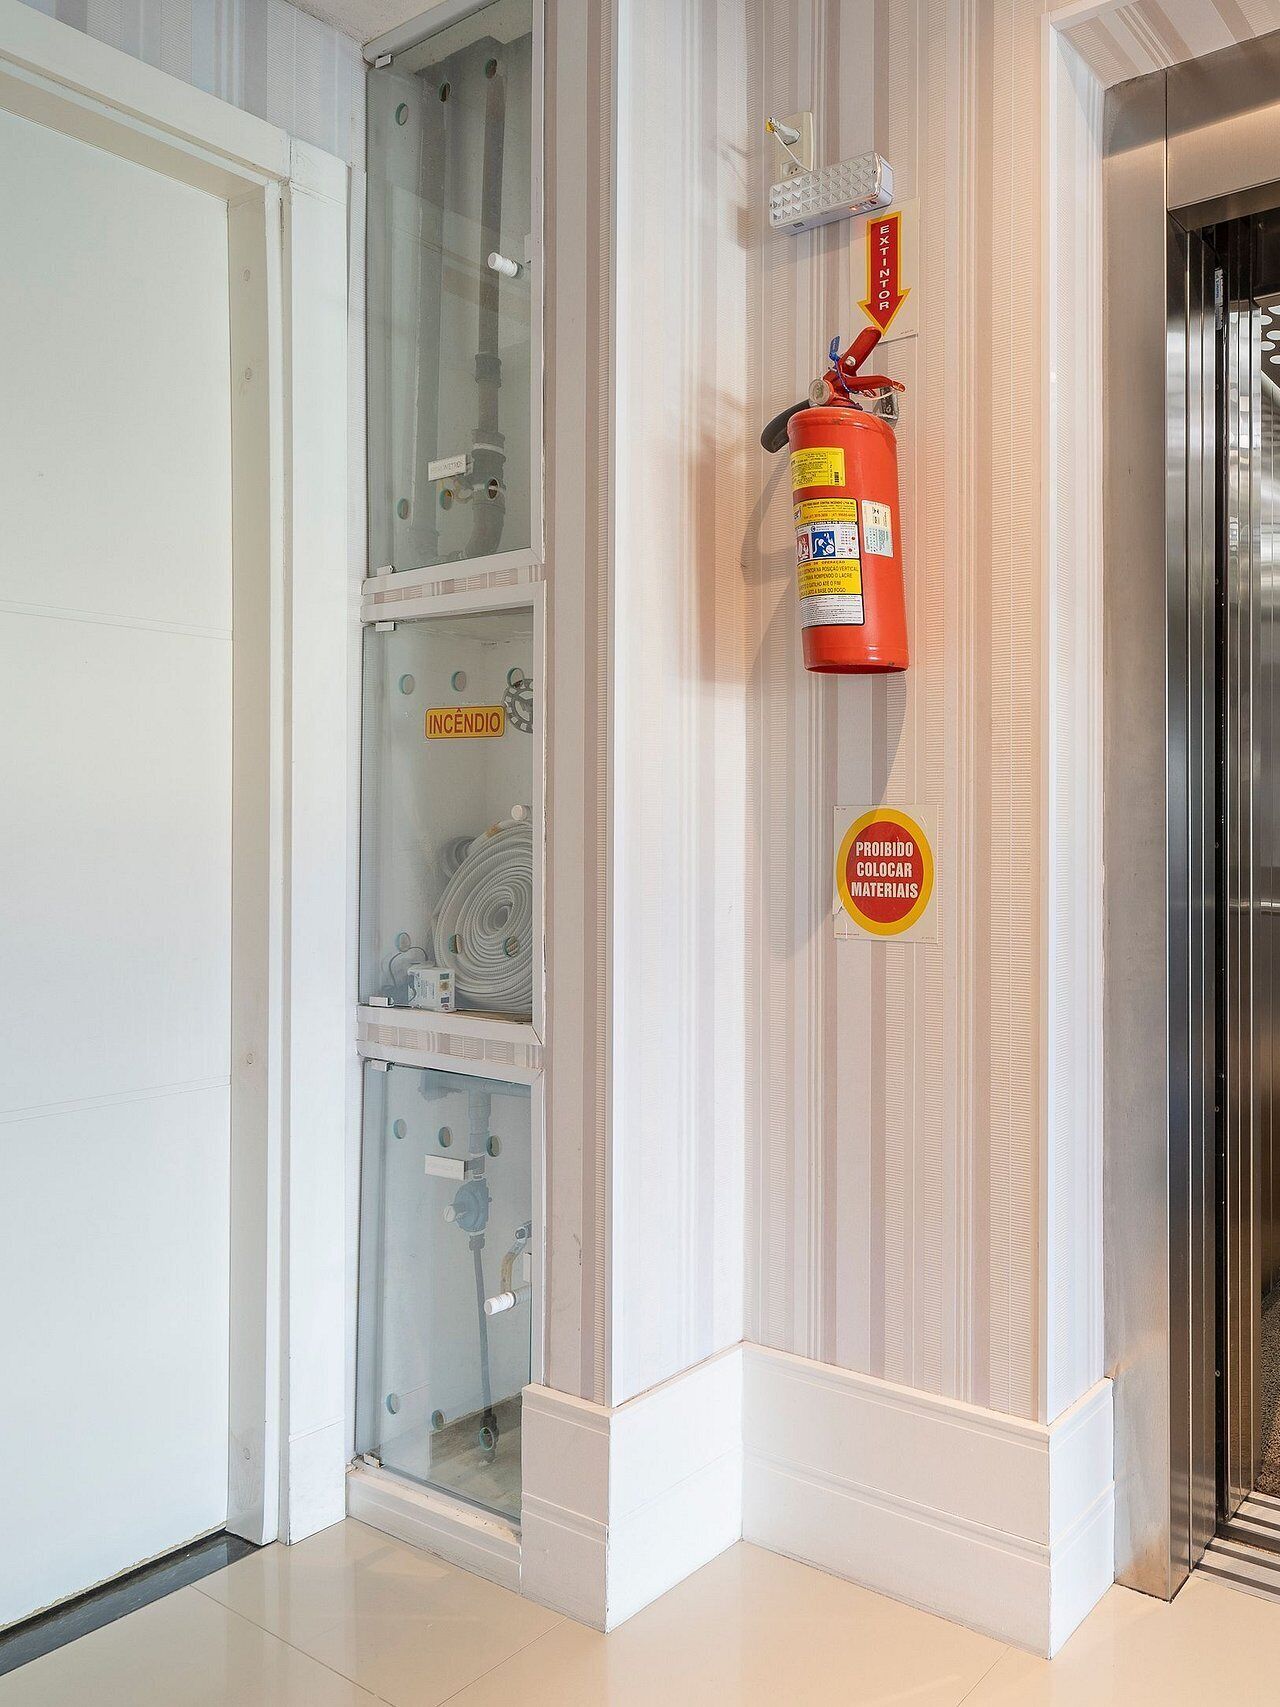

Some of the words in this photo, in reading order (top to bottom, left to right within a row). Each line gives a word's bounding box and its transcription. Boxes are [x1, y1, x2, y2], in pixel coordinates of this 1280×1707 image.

[878, 224, 891, 311] EXTINTOR
[429, 707, 501, 735] INCÊNDIO
[855, 841, 914, 858] PROIBIDO
[856, 861, 913, 878] COLOCAR
[851, 881, 919, 899] MATERIAIS
